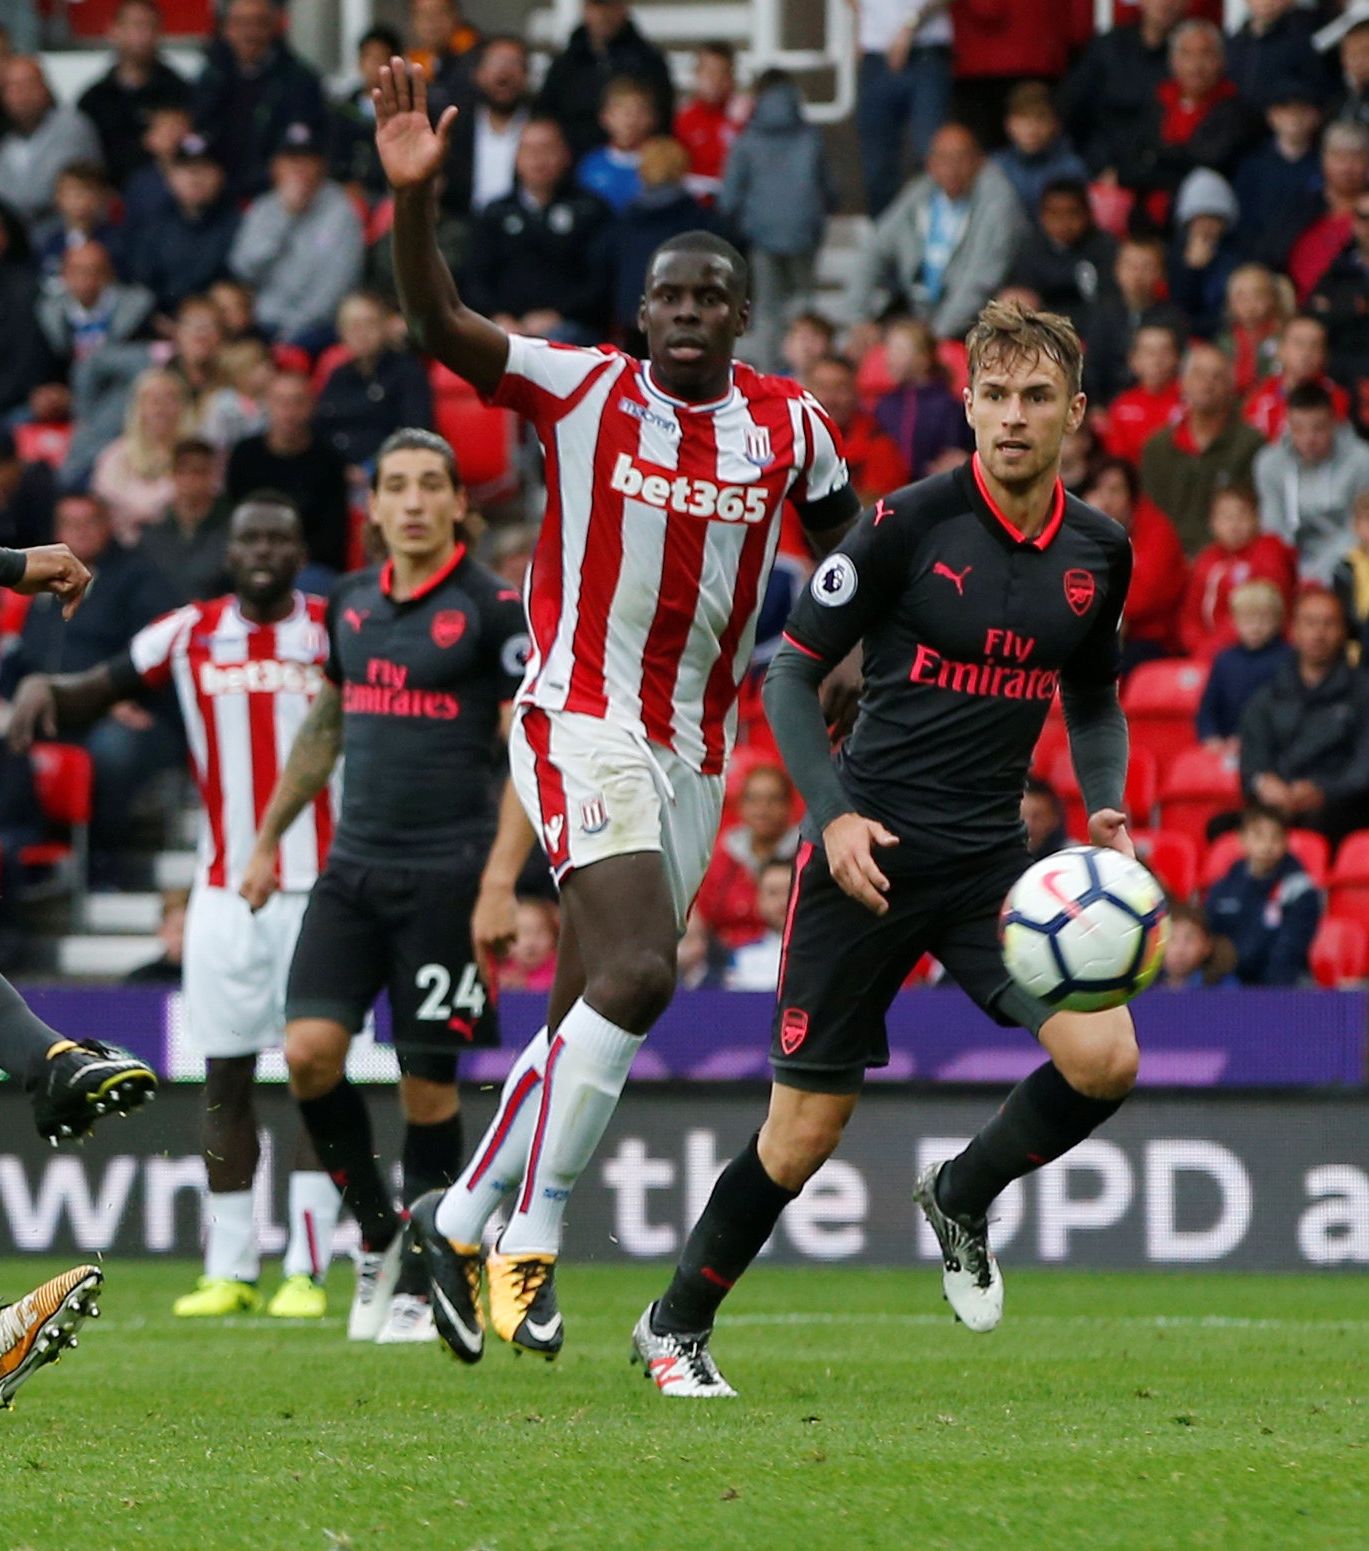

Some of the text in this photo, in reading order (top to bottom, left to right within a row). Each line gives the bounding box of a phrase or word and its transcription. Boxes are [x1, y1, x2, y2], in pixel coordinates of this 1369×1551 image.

[610, 452, 769, 524] bet365
[984, 628, 1035, 663] Fly
[366, 657, 409, 691] Fly
[414, 962, 486, 1020] 24
